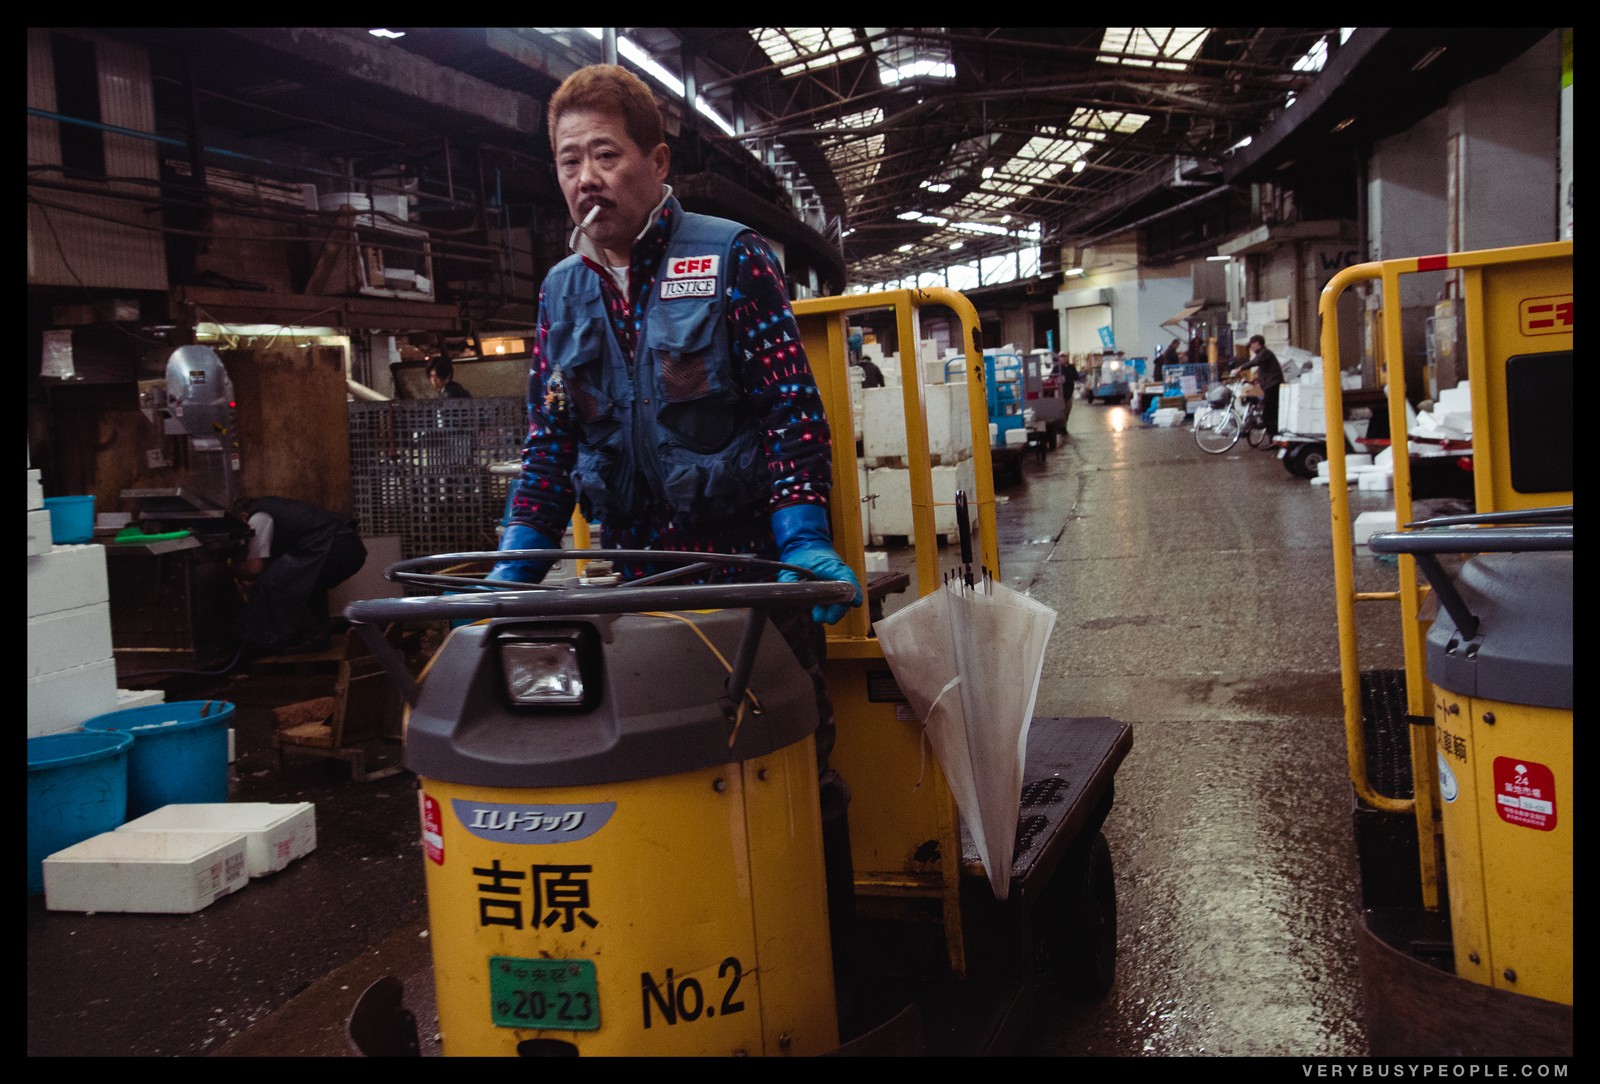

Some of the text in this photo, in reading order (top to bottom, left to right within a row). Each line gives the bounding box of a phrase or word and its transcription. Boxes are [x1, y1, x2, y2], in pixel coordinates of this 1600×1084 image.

[673, 258, 712, 274] CFF
[664, 280, 713, 296] JUSTICE
[1514, 774, 1529, 787] 24
[469, 809, 585, 831] エレトラック
[472, 859, 599, 933] 吉原
[513, 966, 568, 983] 中央区
[641, 957, 745, 1029] No.2
[512, 989, 593, 1021] 20-23
